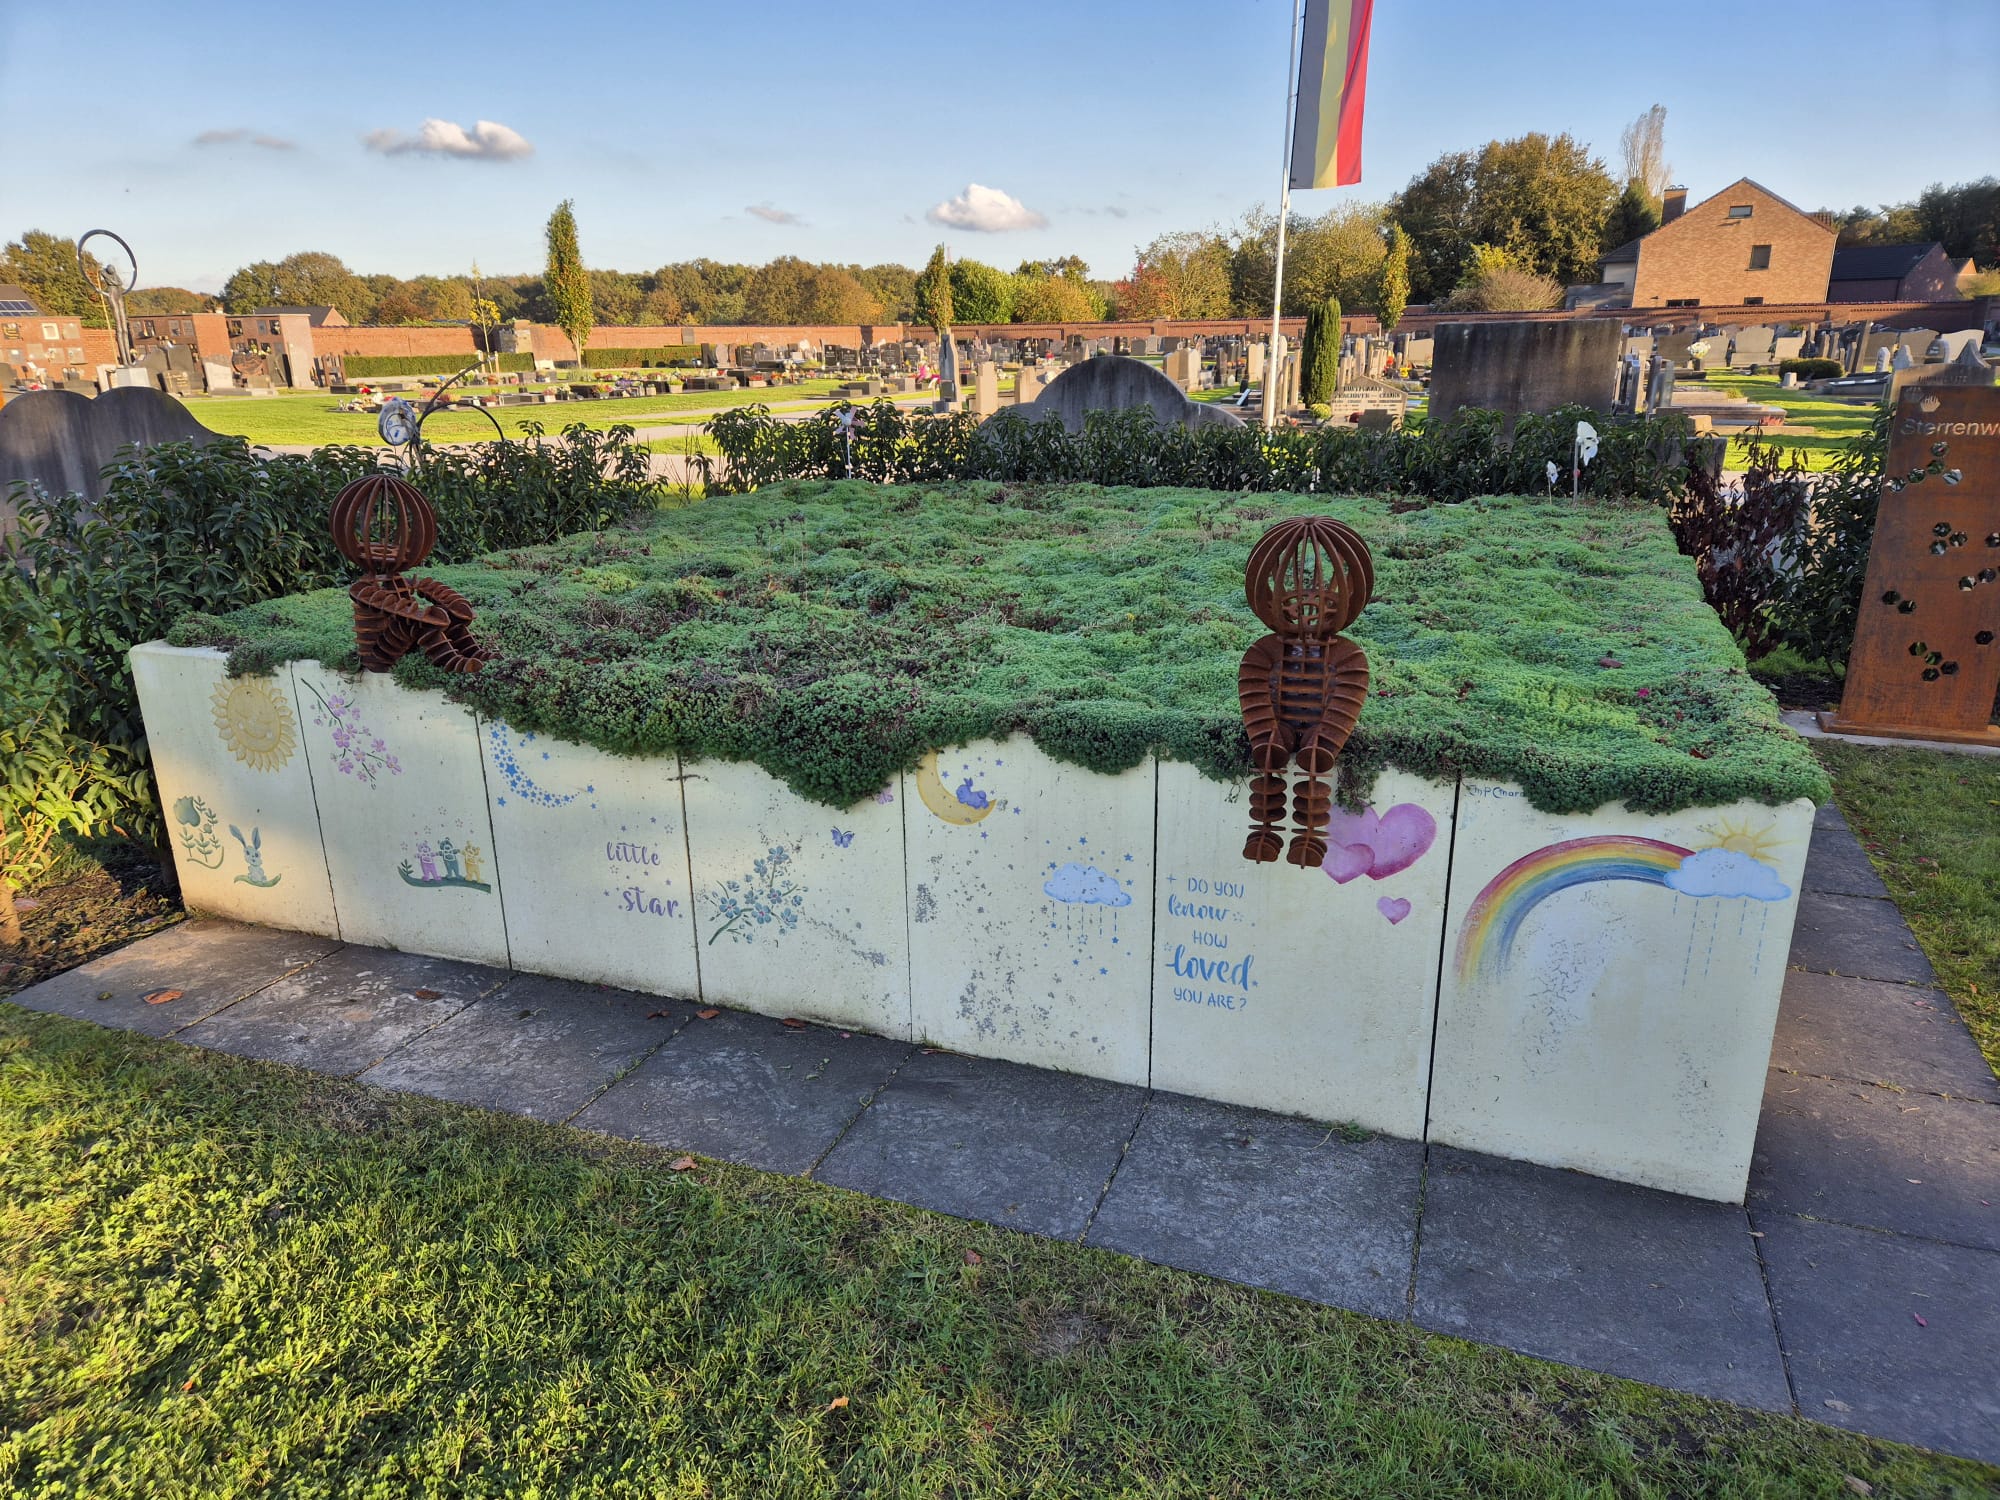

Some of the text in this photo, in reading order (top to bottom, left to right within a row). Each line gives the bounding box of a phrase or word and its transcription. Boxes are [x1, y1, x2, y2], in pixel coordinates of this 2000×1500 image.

[1901, 419, 2000, 436] Sterrenw
[606, 841, 660, 866] little
[1188, 877, 1245, 899] DO YOU
[1168, 894, 1230, 921] know
[1192, 929, 1228, 949] HOW
[1166, 944, 1254, 991] loved
[1173, 987, 1203, 1004] YOU
